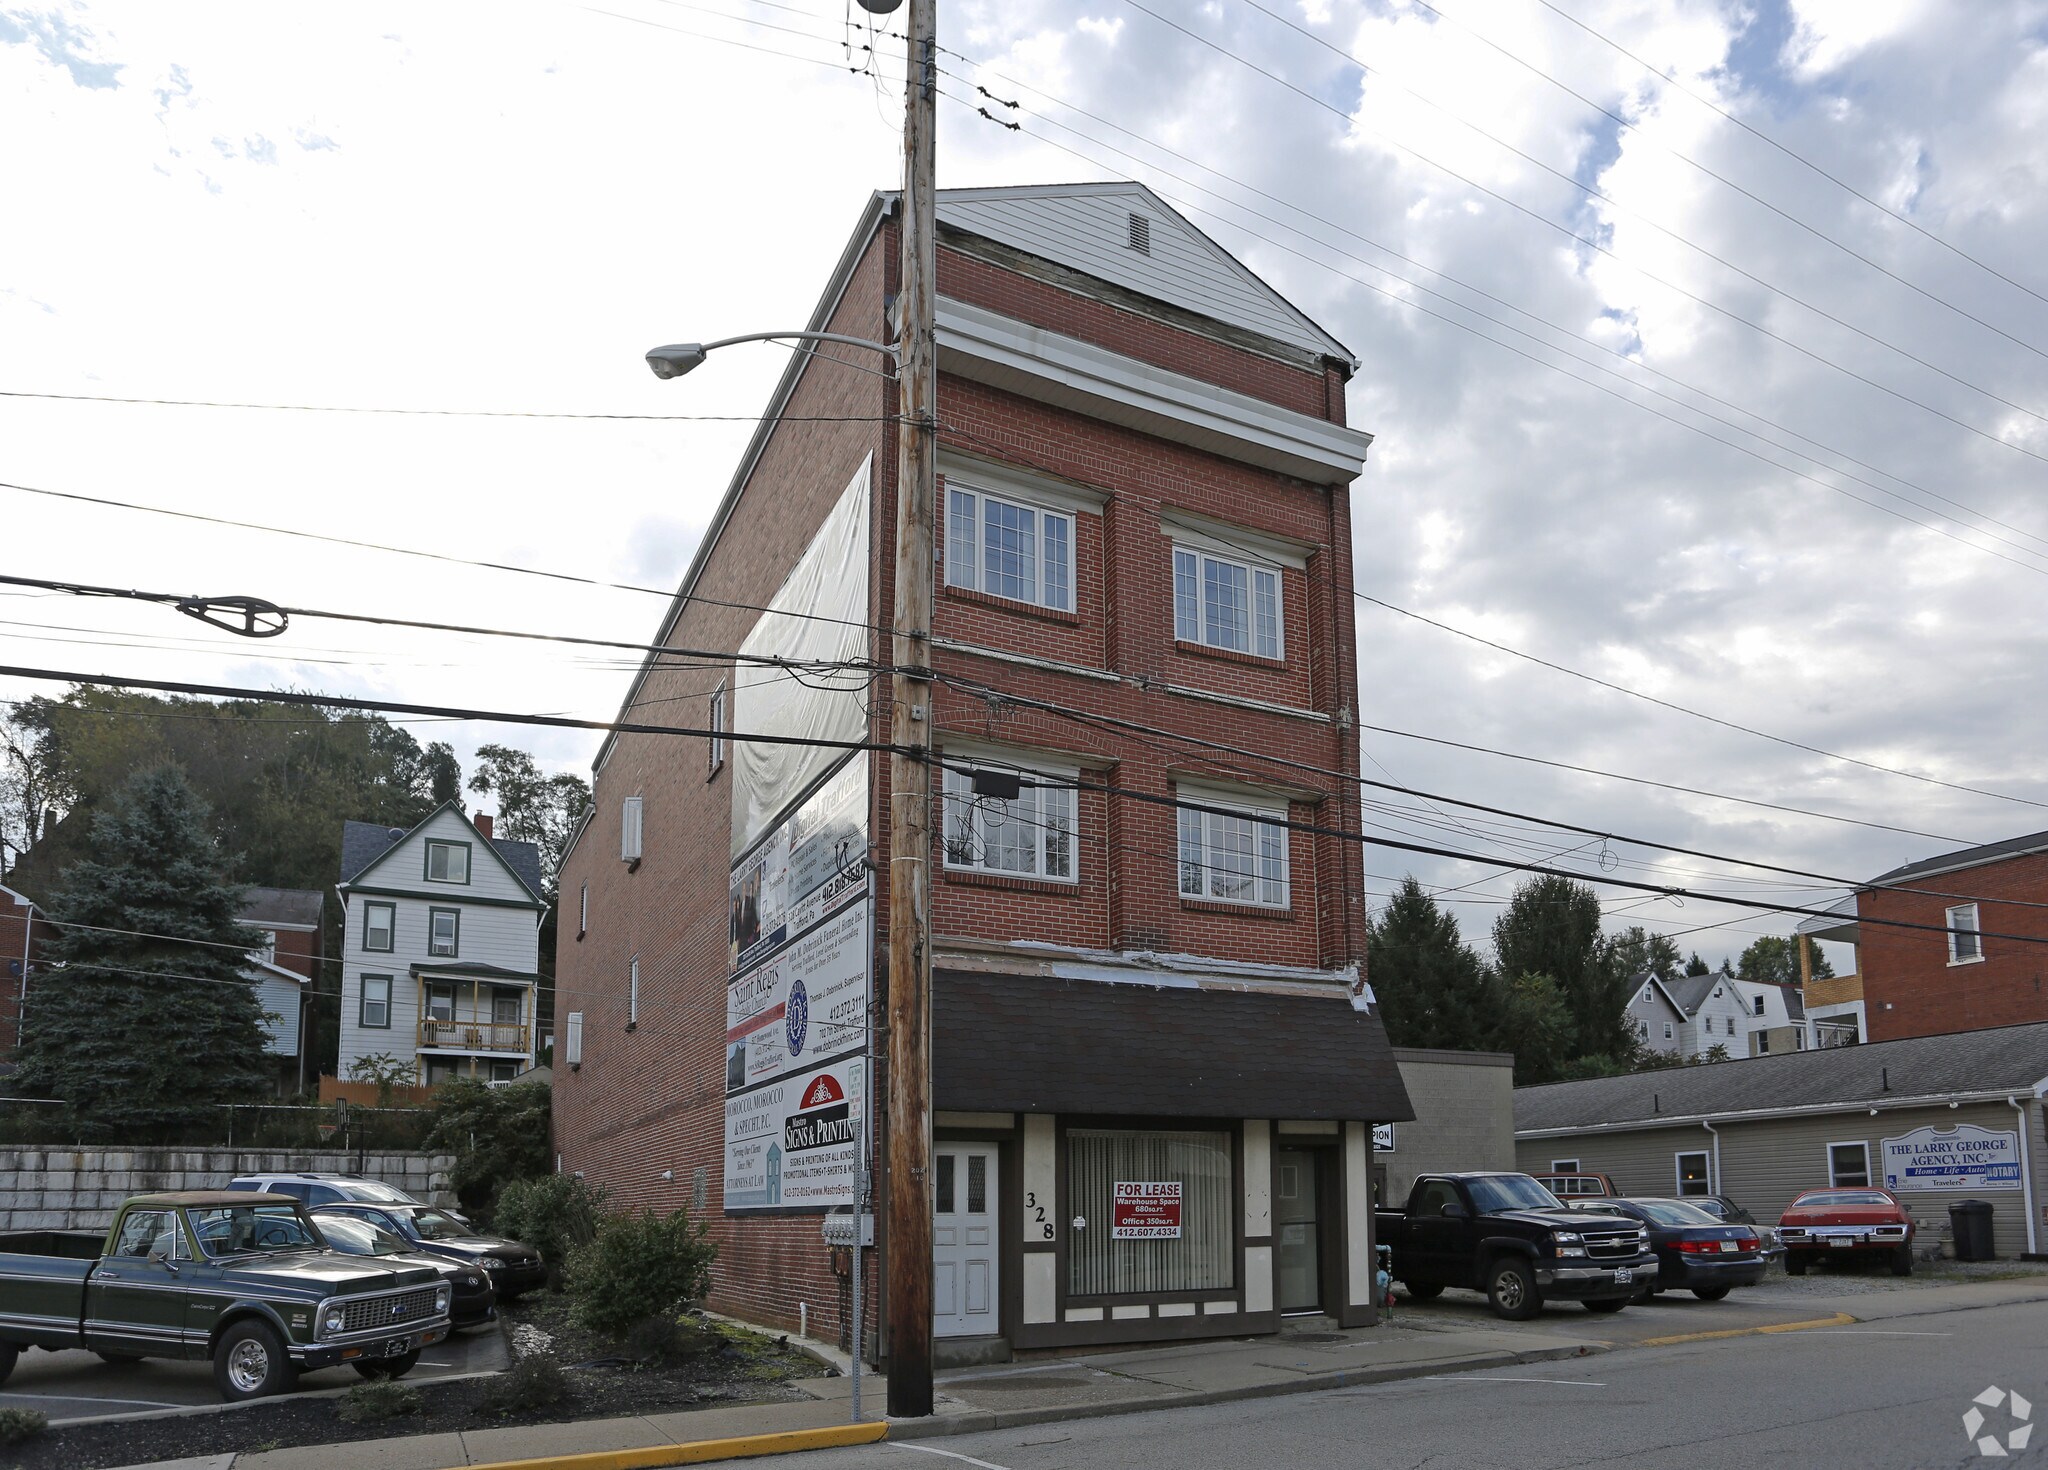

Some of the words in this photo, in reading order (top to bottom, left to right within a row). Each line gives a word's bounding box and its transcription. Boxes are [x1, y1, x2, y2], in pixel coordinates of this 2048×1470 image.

[821, 761, 863, 816] Trafford
[823, 922, 841, 943] Funeral
[842, 916, 854, 932] Home
[734, 979, 754, 1007] Saint
[756, 961, 779, 998] Regis
[844, 972, 865, 988] Supervisor
[829, 994, 865, 1021] 412.372.3111
[847, 1012, 865, 1029] Trafford
[753, 1087, 784, 1110] MOROCCO
[786, 1126, 808, 1149] SIGNS
[808, 1125, 815, 1145] &
[816, 1118, 854, 1144] PRINTIN
[1372, 1130, 1389, 1140] PION
[1889, 1144, 1913, 1155] THE
[1913, 1142, 1954, 1154] LARRY
[1956, 1139, 2008, 1152] GEORGE
[789, 1156, 801, 1167] SIGNS
[805, 1153, 825, 1164] PRINTING
[840, 1149, 854, 1161] KINDS
[1910, 1155, 1961, 1167] AGENCY,
[1963, 1153, 1987, 1164] INC.
[783, 1169, 809, 1180] PROMOTIONAL
[1965, 1166, 1985, 1174] Auto
[1986, 1167, 2019, 1178] NOTARY
[1117, 1183, 1142, 1196] FOR
[1146, 1184, 1180, 1196] LEASE
[1932, 1179, 1962, 1187] Travelers
[1117, 1197, 1158, 1205] Warehouse
[1159, 1198, 1179, 1206] Space
[1122, 1217, 1145, 1225] Office
[1117, 1227, 1177, 1237] 412.607.4334
